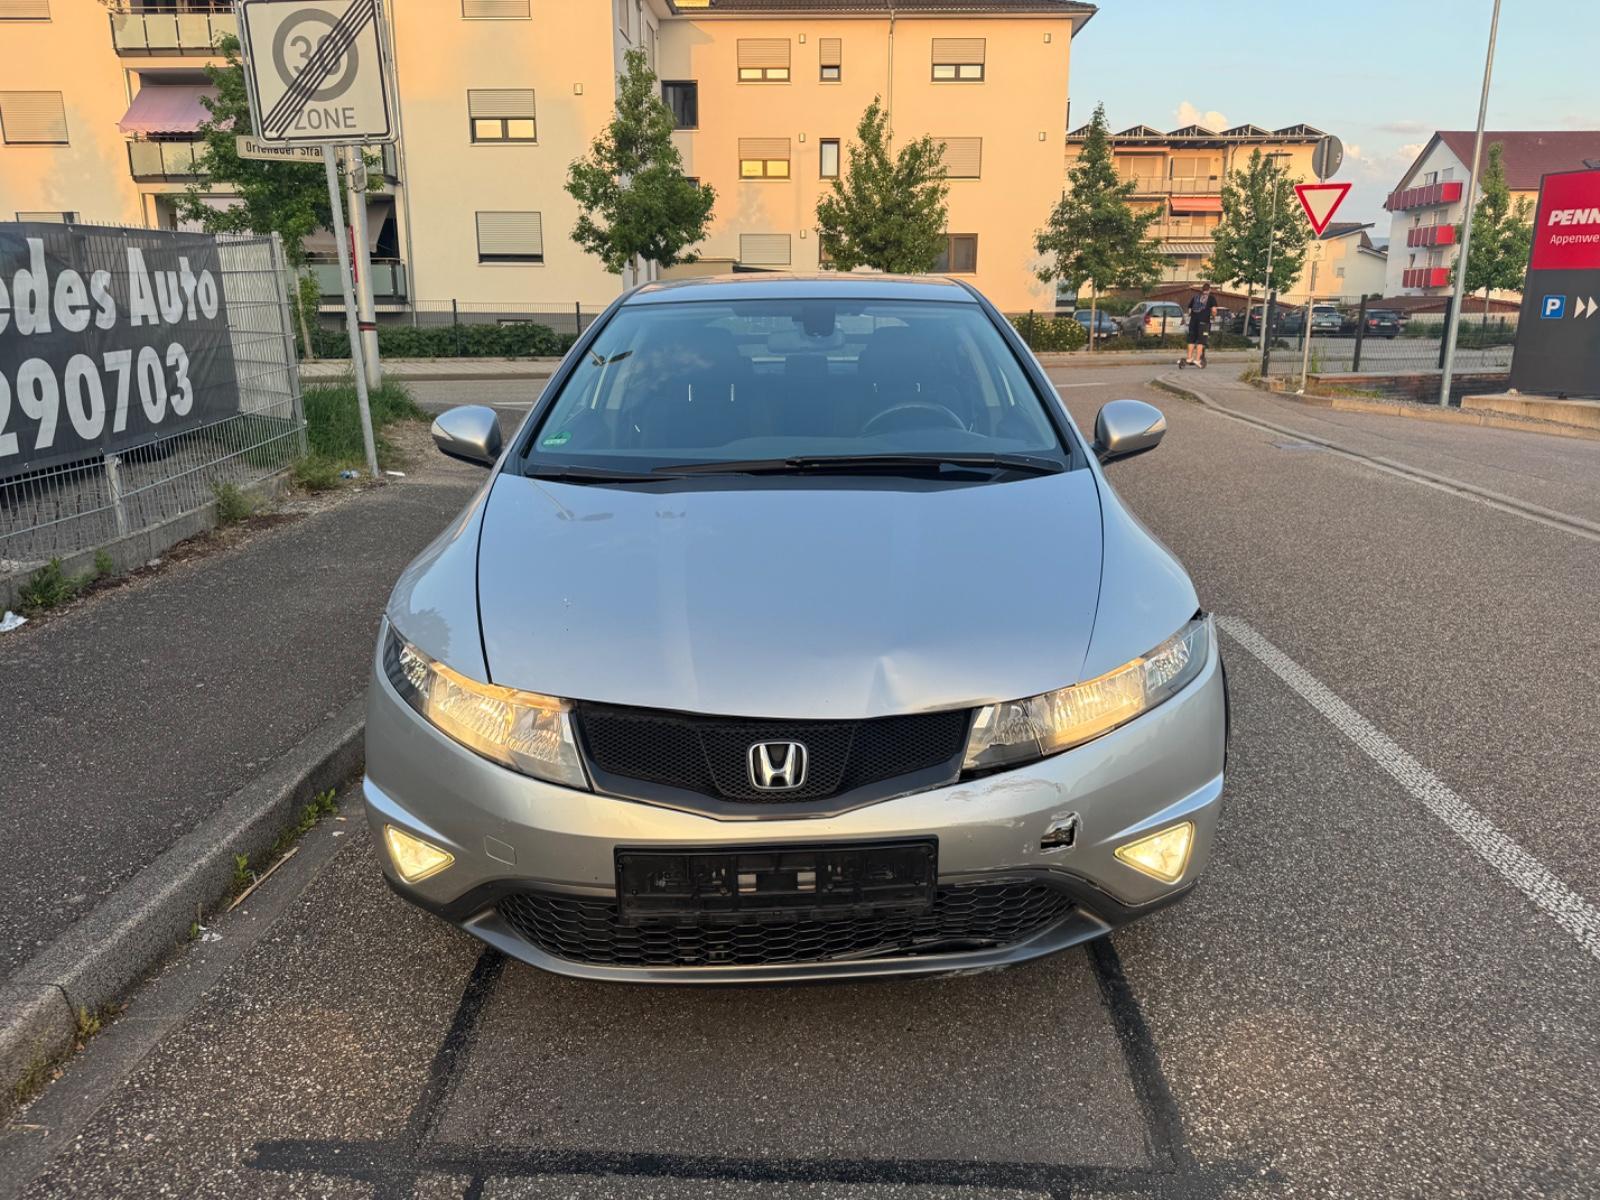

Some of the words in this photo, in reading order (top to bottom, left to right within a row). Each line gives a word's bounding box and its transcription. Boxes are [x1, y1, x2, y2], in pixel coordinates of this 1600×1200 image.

[294, 107, 357, 131] ZONE
[300, 147, 324, 157] Stra
[1550, 234, 1600, 246] Appenwe
[0, 237, 117, 336] des
[127, 247, 218, 328] Auto
[1544, 298, 1561, 316] P
